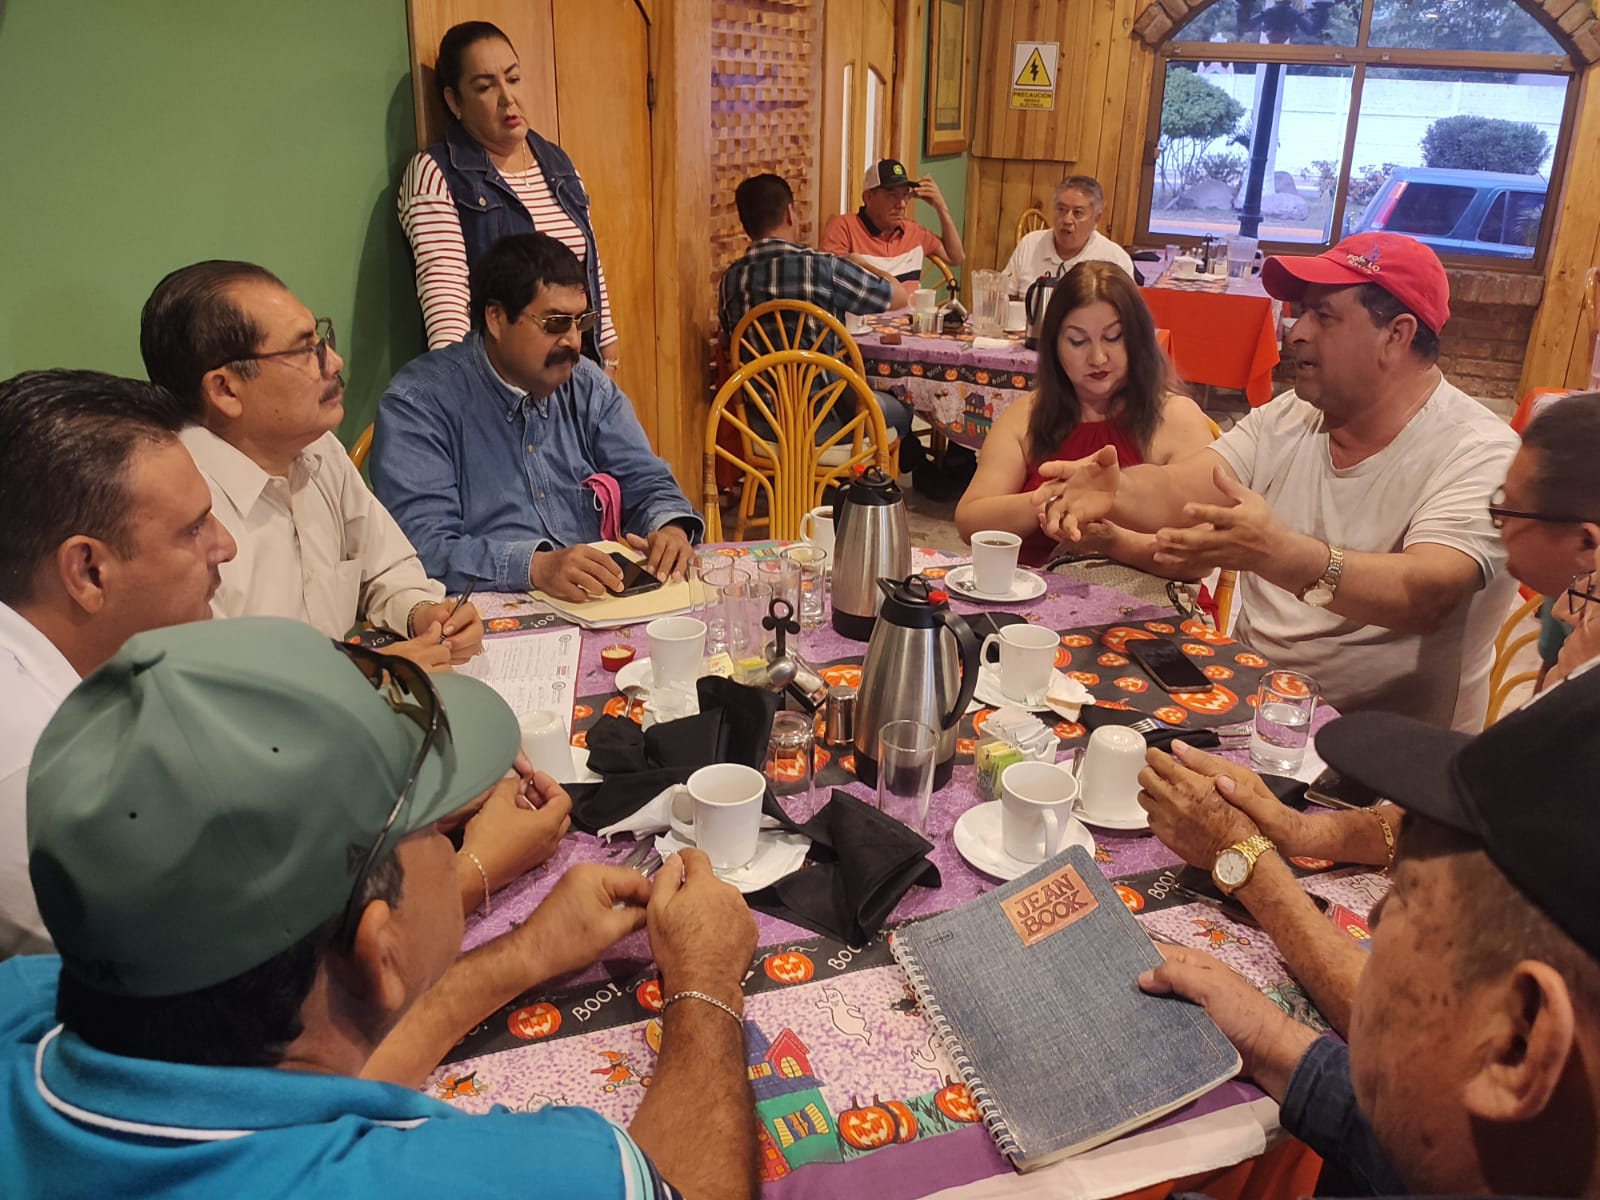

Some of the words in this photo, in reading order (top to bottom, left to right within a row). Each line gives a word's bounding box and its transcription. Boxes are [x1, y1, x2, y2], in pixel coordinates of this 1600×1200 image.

[1014, 873, 1075, 918] JEAN
[1020, 890, 1088, 936] BOOK
[572, 983, 622, 1022] BOO!
